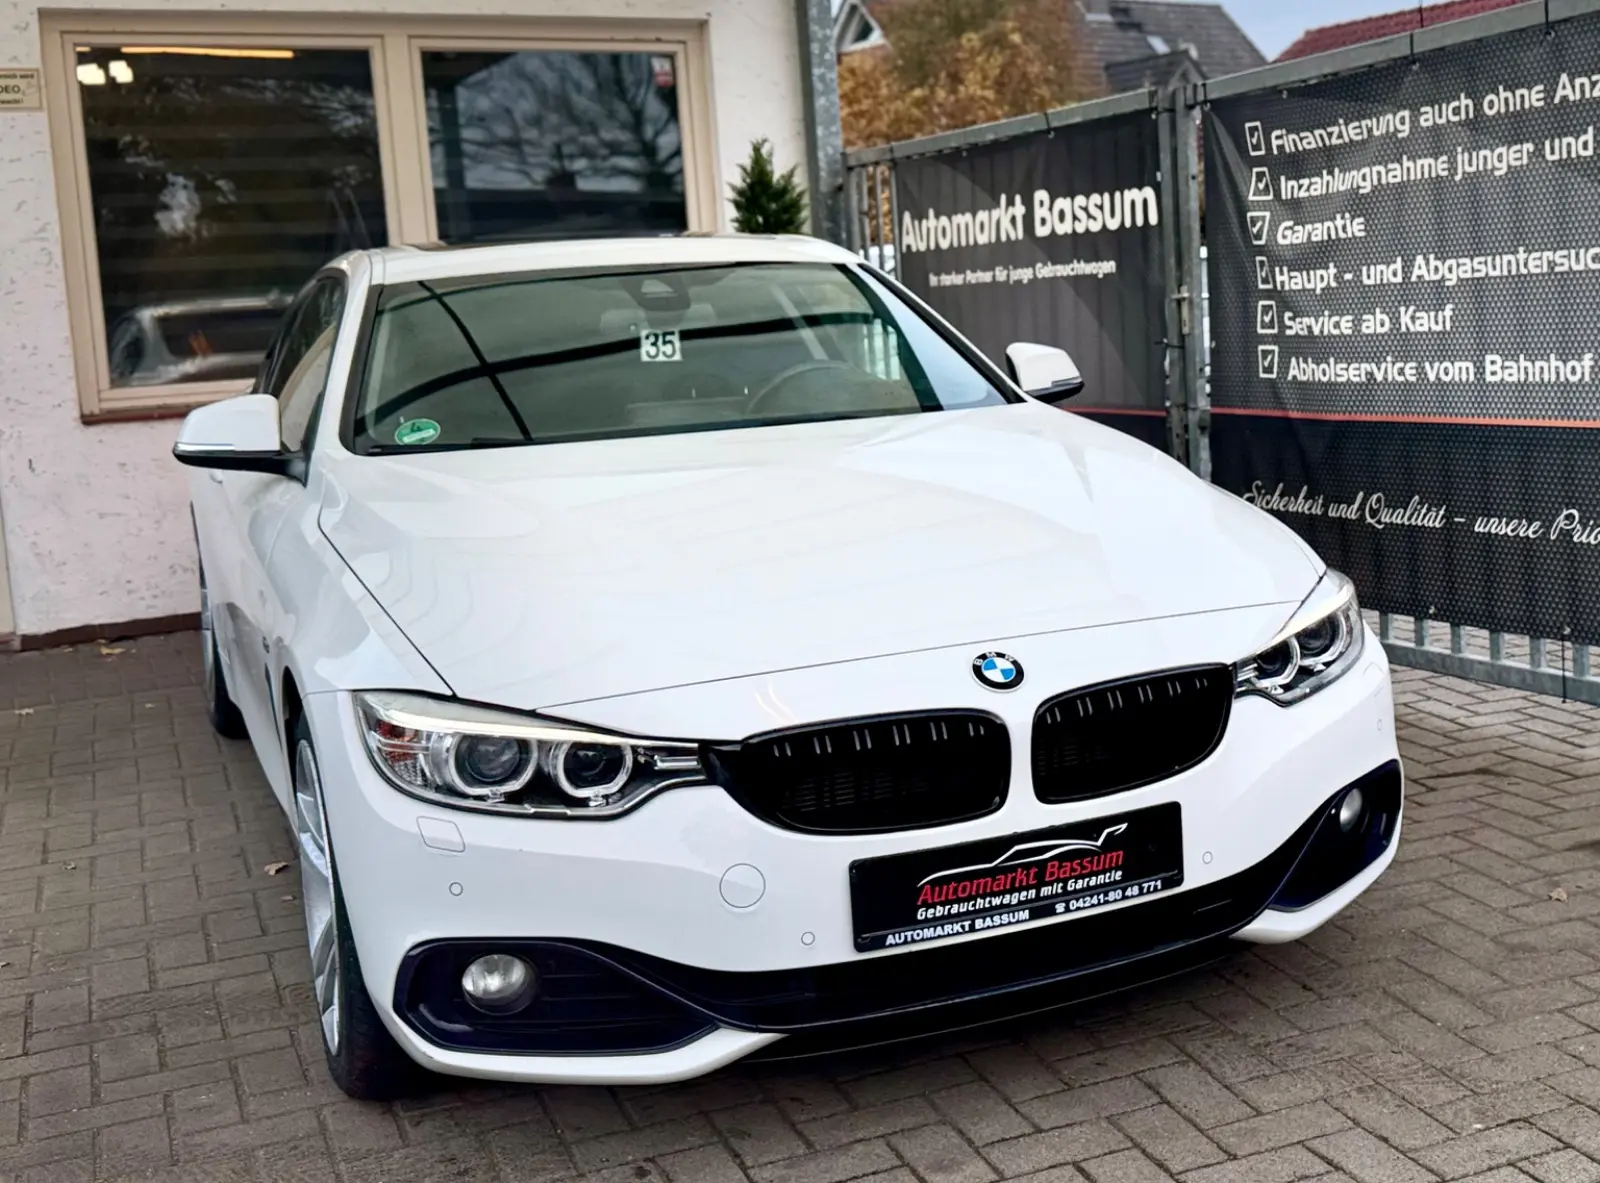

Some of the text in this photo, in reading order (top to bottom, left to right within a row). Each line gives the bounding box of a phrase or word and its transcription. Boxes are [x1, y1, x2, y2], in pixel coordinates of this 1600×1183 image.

[1271, 73, 1600, 155] Finanzierung auch ohne Anz
[1280, 125, 1594, 199] Inzahlungnahme junger und
[901, 185, 1159, 253] Automarkt Bassum
[1276, 213, 1365, 245] Garantie
[1009, 265, 1034, 284] junge
[1035, 258, 1117, 279] Gebrauchtwagen
[1275, 262, 1337, 294] Haupt
[1362, 257, 1403, 285] und
[1410, 246, 1600, 286] Abgasuntersuc
[644, 331, 677, 359] 35
[1284, 304, 1453, 336] Service ab Kauf
[1287, 353, 1594, 383] Abholservice vom Bahnhof
[1242, 480, 1325, 516] Sicherheit
[1328, 491, 1364, 520] und
[1365, 492, 1446, 529] Qualität
[1474, 516, 1545, 539] unsere
[917, 850, 1124, 906] Automarkt Bassum
[917, 870, 1123, 920] Gebrauchtwagen mit Garantie
[885, 880, 1162, 946] AUTOMARKT BASSUM 04241-80 48 771
